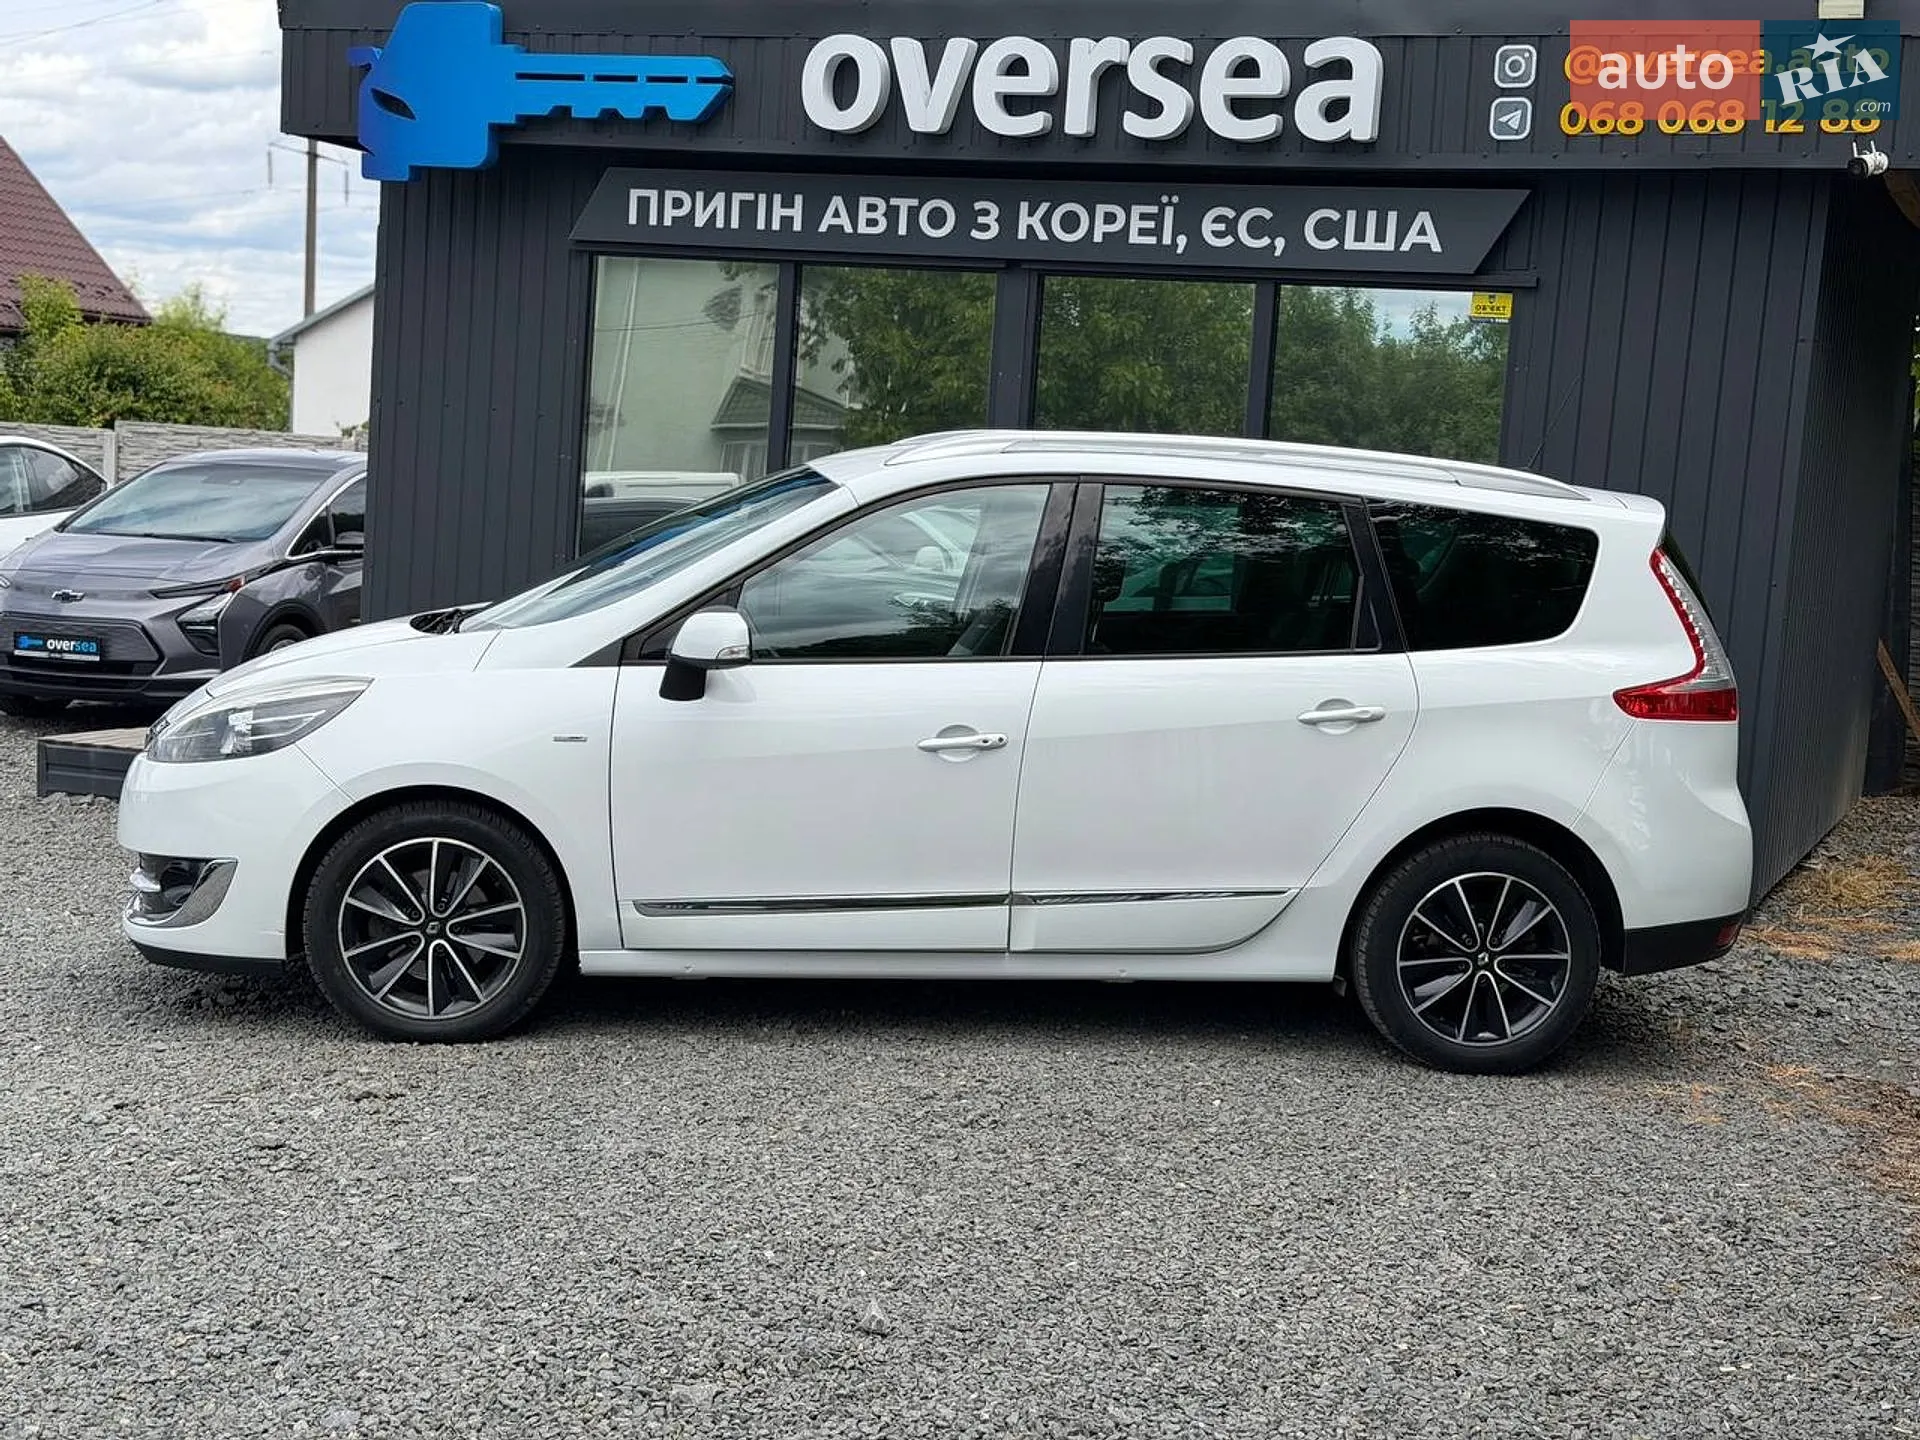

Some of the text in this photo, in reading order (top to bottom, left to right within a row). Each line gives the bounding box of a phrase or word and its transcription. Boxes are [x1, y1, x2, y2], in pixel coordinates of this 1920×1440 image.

[801, 33, 1384, 143] oversea
[1559, 98, 1882, 136] 068 068 12 88
[627, 187, 1443, 258] ПРИГІН АВТО З КОРЕЇ, ЄС, США
[46, 638, 97, 653] oversea
